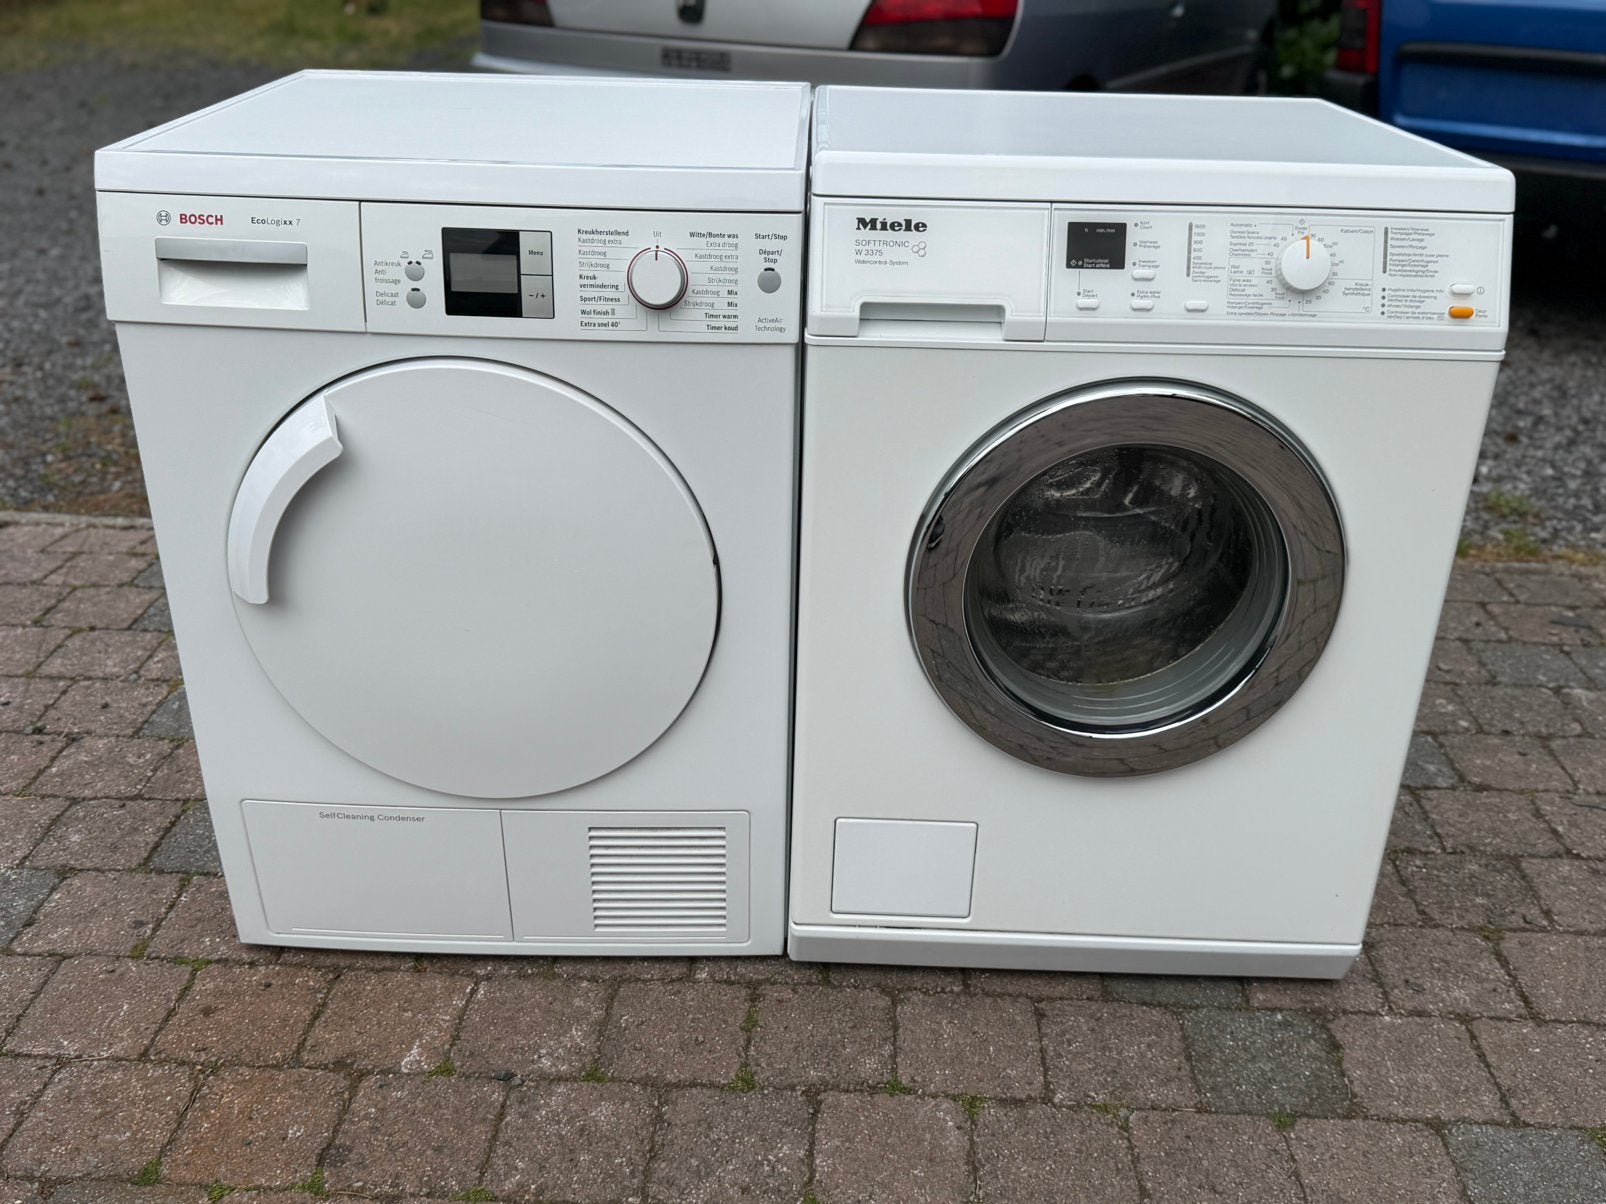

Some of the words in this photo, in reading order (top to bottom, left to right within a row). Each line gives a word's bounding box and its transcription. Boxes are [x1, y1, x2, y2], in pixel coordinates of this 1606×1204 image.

[179, 213, 224, 226] BOSCH
[250, 216, 293, 227] EcoLogixx
[295, 218, 301, 226] 7
[855, 217, 928, 233] Miele
[577, 228, 629, 237] Kreukherstellend
[653, 230, 662, 238] Uit
[689, 231, 726, 239] Witte/Bonte
[754, 232, 788, 241] Start/Stop
[578, 237, 607, 245] Kastdroog
[705, 240, 721, 248] Extra
[721, 240, 739, 249] droog
[855, 239, 910, 248] SOFTTRONIC
[578, 249, 608, 257] Kastdroog
[694, 252, 724, 261] Kastdroog
[723, 253, 739, 261] extra
[758, 247, 783, 257] Départ/
[864, 249, 884, 257] 3375
[374, 260, 402, 268] Antikreuk
[578, 261, 610, 270] Strijkdroog
[763, 257, 778, 265] Stop
[710, 265, 739, 274] Kastdroog
[707, 276, 739, 286] Strijkdroog
[579, 283, 619, 291] vermindering
[691, 288, 721, 297] Kastdroog
[579, 295, 621, 303] Sport/Fitness
[683, 300, 715, 309] Strijkdroog
[580, 308, 592, 316] Wol
[592, 308, 610, 317] finish
[704, 312, 721, 320] Timer
[580, 320, 597, 328] Extra
[597, 320, 610, 328] snel
[706, 324, 723, 332] Timer
[723, 324, 739, 332] koud
[755, 325, 787, 334] Technology
[377, 813, 425, 823] Condenser
